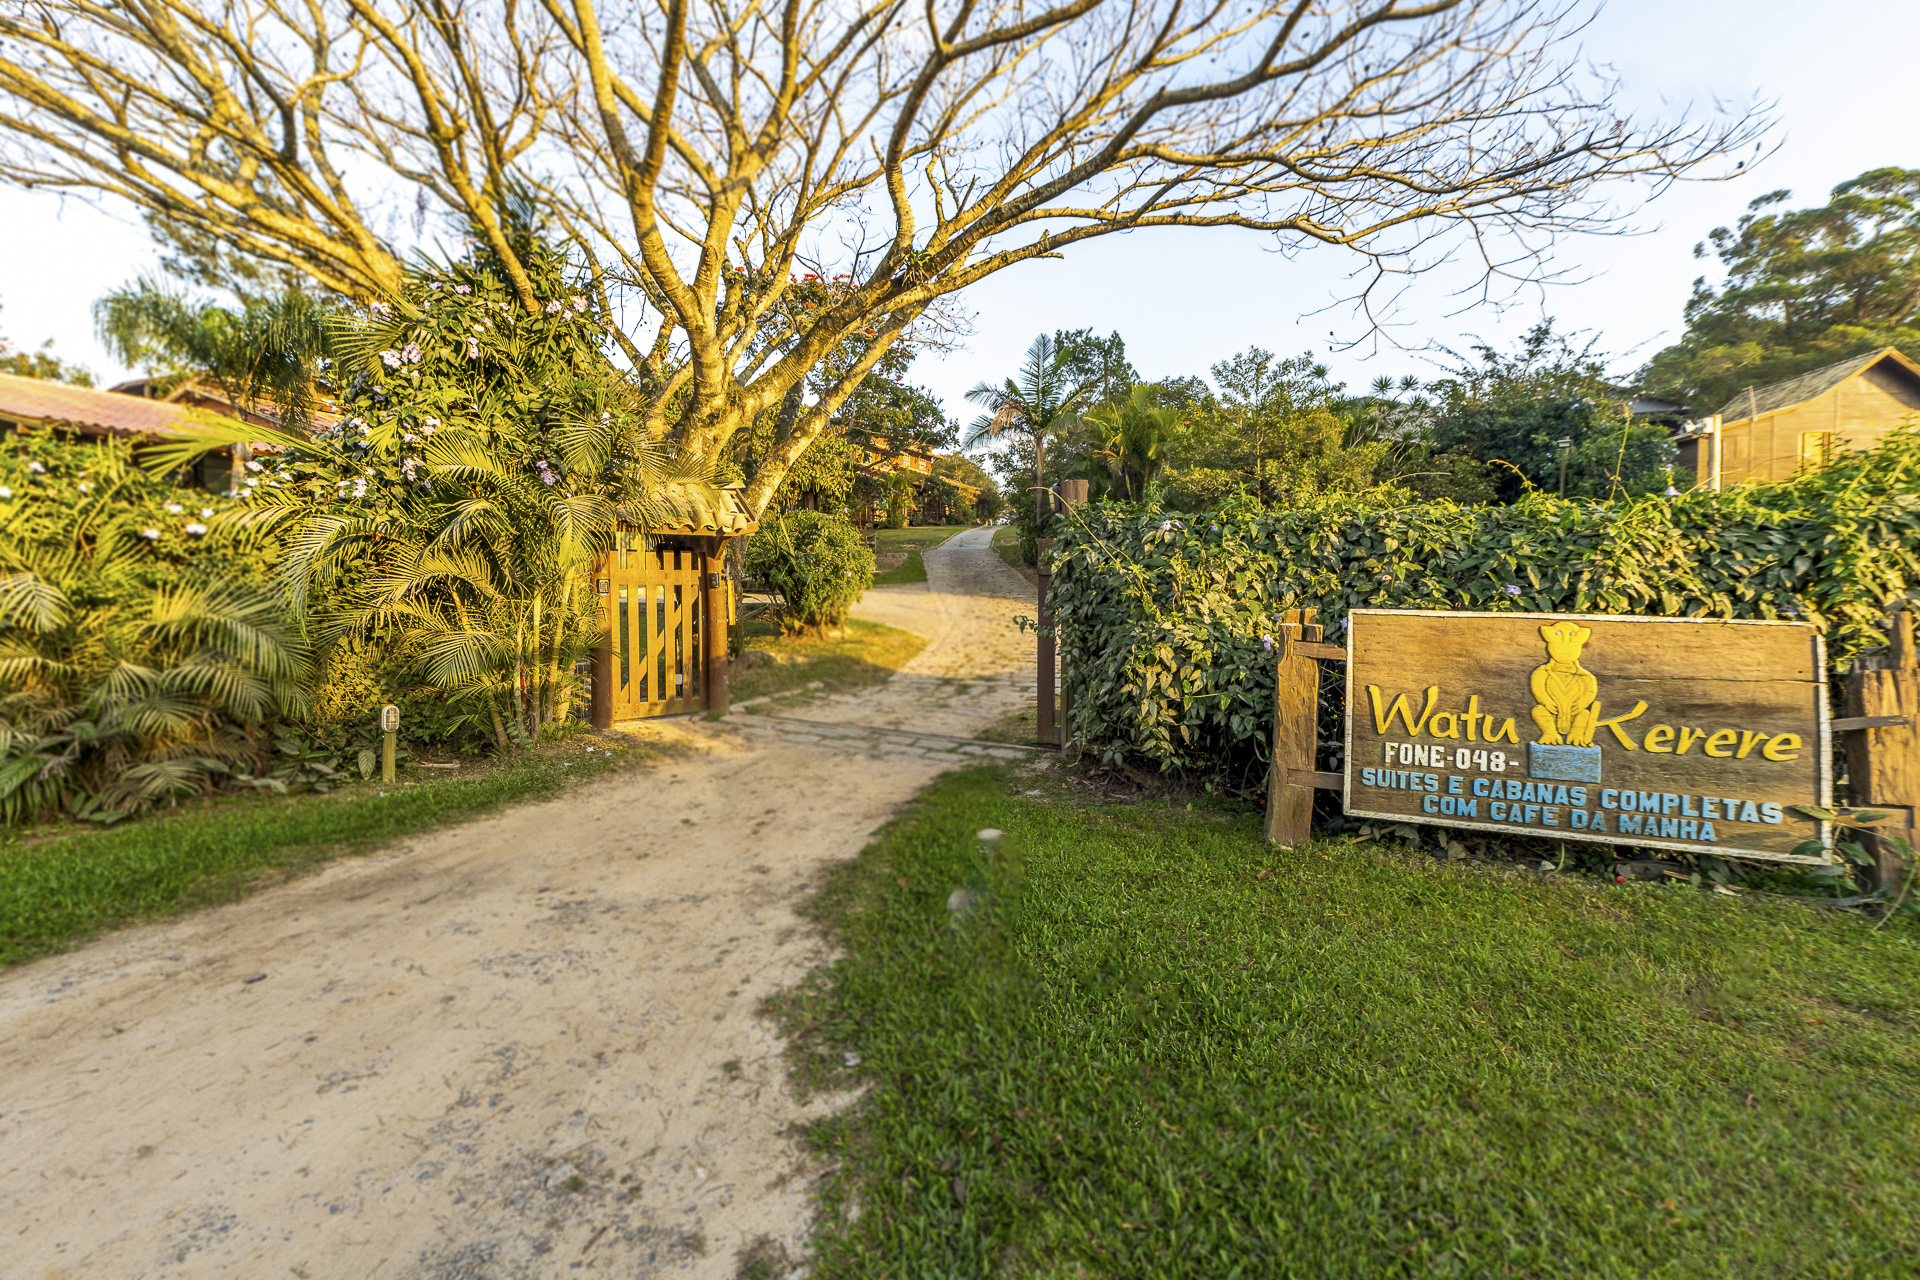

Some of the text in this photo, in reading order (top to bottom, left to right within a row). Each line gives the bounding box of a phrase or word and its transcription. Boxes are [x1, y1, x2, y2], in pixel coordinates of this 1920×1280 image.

[1368, 684, 1802, 762] Watu Kerere
[1362, 768, 1783, 824] SUITES E CABANAS COMPLETAS
[1423, 795, 1716, 842] COM CAFE DA MANHA
